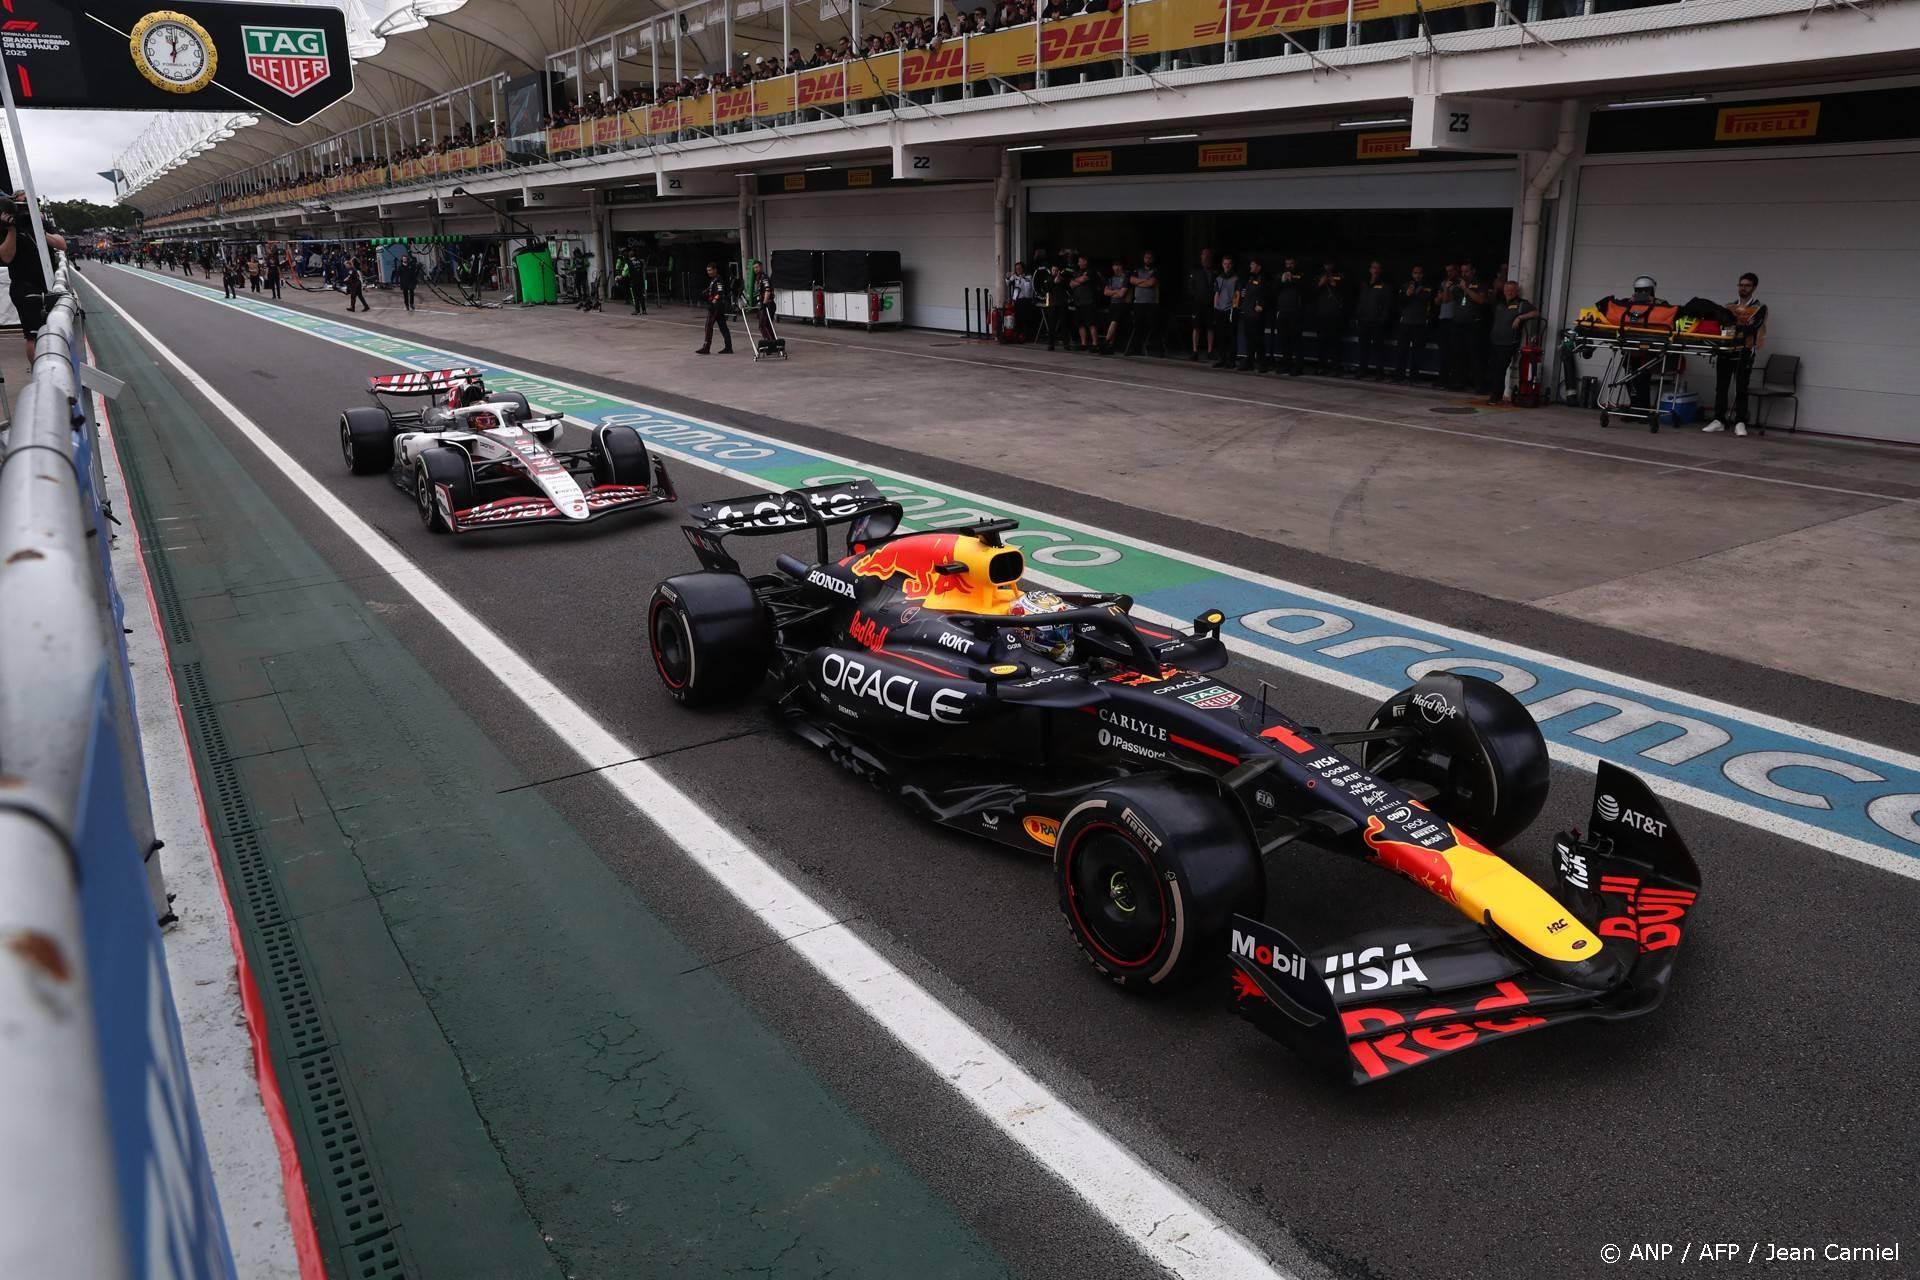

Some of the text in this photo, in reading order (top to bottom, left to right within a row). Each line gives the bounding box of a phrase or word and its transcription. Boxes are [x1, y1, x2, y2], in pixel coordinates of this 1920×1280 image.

[249, 31, 320, 54] TAG
[1034, 16, 1125, 64] DHL
[252, 58, 325, 91] HEUER
[901, 47, 970, 85] DHL
[798, 71, 850, 104] DHL
[716, 90, 759, 118] DHL
[597, 119, 627, 142] DHL
[650, 105, 686, 131] DHL
[1449, 113, 1470, 132] 23
[1724, 109, 1810, 134] PIRELLI
[1202, 147, 1243, 162] PIRELLI
[1363, 136, 1412, 153] PIREL
[913, 156, 930, 169] 22
[1076, 154, 1109, 169] PIRELLI
[532, 192, 544, 200] 20
[669, 179, 682, 188] 21
[601, 412, 777, 461] aramco
[808, 570, 857, 600] HONDA
[938, 631, 975, 655] ROKT
[822, 653, 970, 725] ORACLE
[1153, 676, 1211, 695] ORACLE
[1185, 687, 1224, 701] TAG
[1412, 693, 1457, 719] Hard Rock
[1099, 708, 1168, 742] CARLYLE
[1238, 607, 1920, 850] aramc
[1260, 725, 1314, 753] 1
[1309, 756, 1340, 770] VISA
[1342, 772, 1362, 784] AT&T
[1386, 808, 1406, 822] CDW
[1621, 808, 1667, 839] AT&T
[1121, 807, 1163, 854] PIRELLI
[1420, 836, 1442, 847] Mobil
[1547, 918, 1569, 934] HRC
[1231, 929, 1307, 982] Mobil
[1324, 943, 1429, 995] VISA
[1340, 981, 1548, 1079] Red
